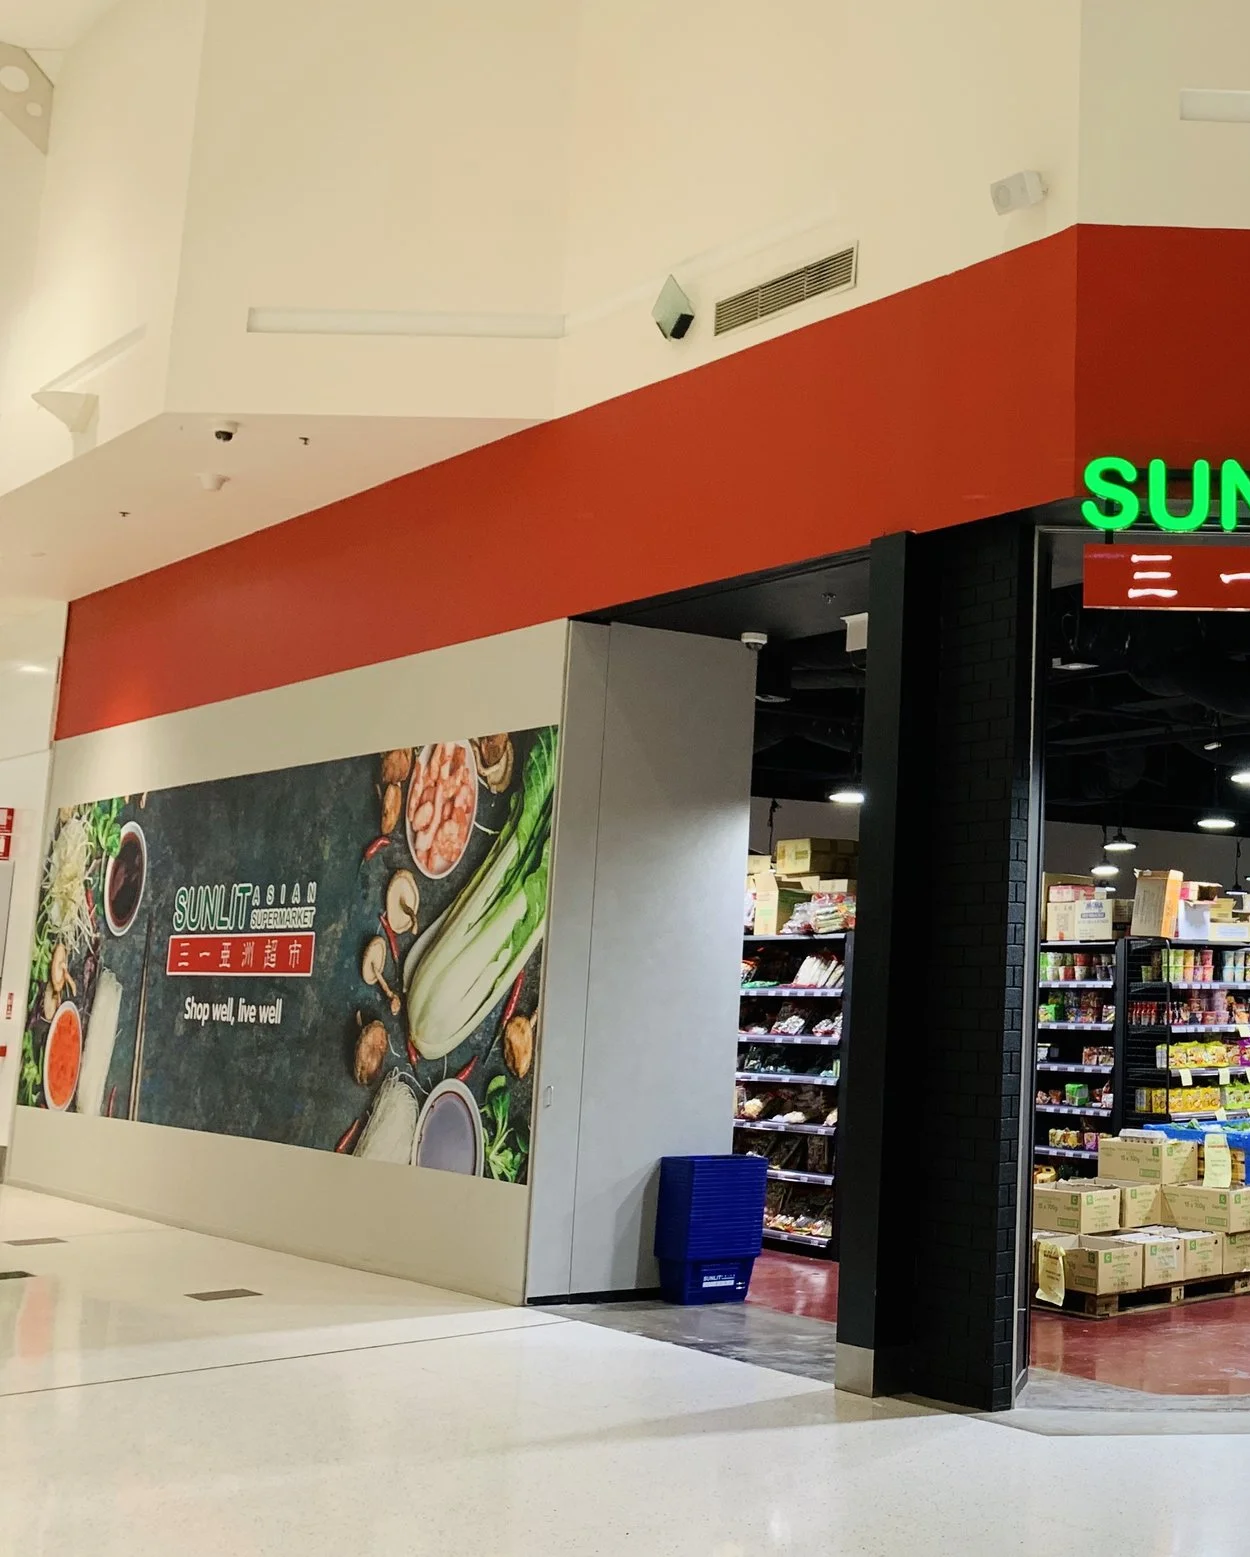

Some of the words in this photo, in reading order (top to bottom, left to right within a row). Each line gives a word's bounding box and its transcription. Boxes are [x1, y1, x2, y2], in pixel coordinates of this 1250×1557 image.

[173, 883, 253, 932] SUNLIT
[252, 881, 317, 906] ASIAN
[251, 906, 316, 930] SUPERMARKET
[184, 996, 211, 1026] Shop
[212, 997, 235, 1025] well,
[237, 998, 257, 1023] live
[259, 998, 283, 1024] well
